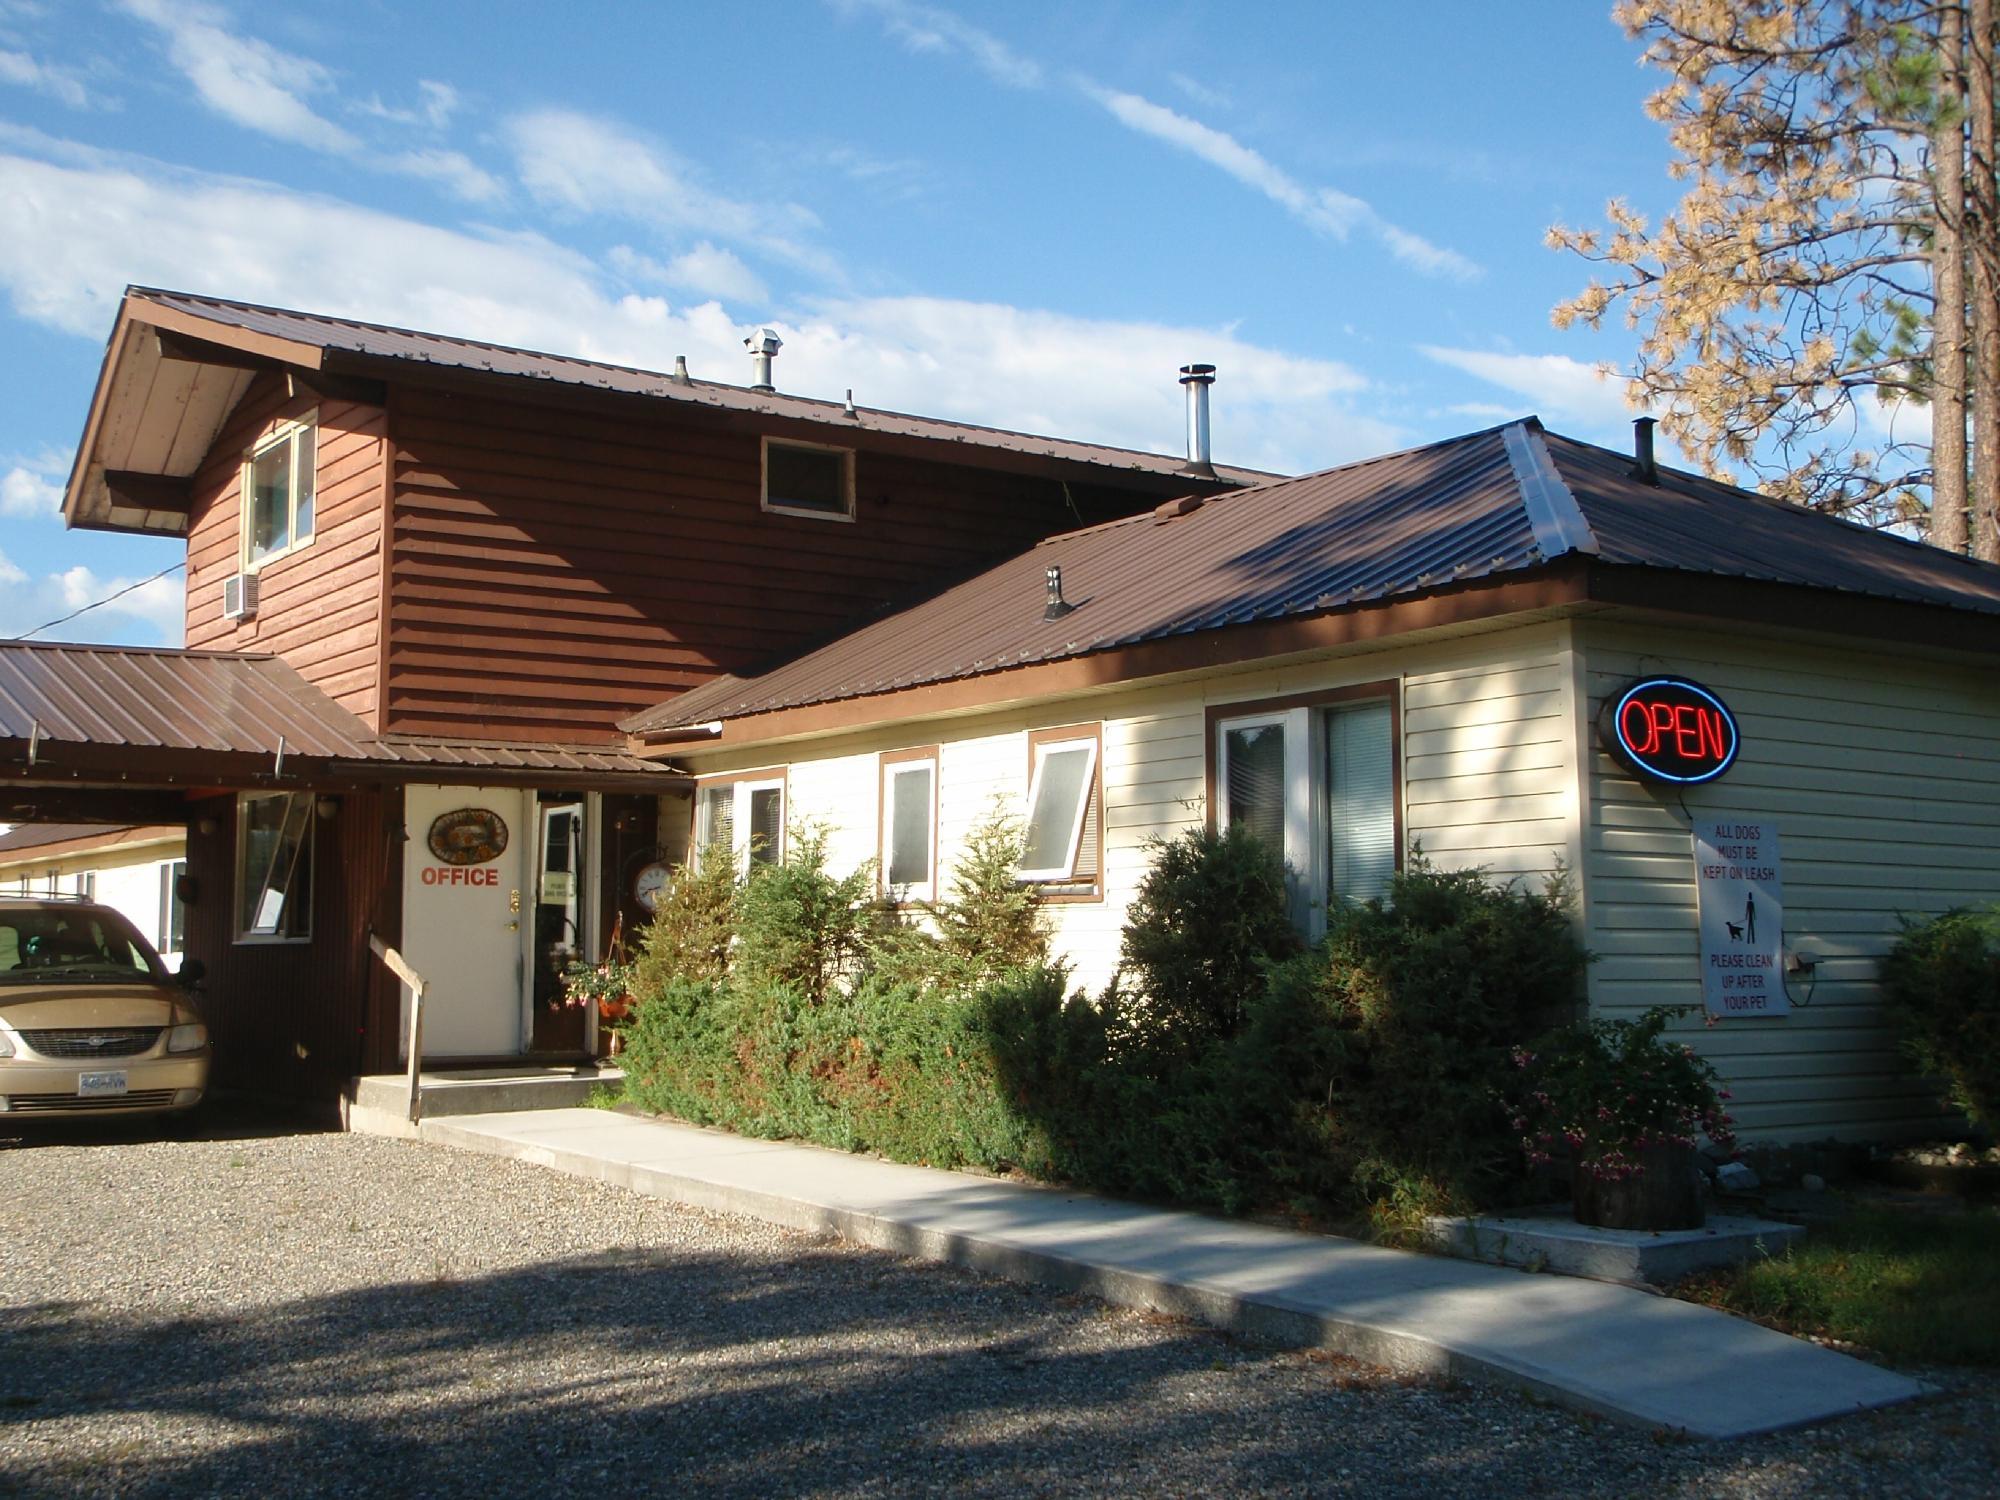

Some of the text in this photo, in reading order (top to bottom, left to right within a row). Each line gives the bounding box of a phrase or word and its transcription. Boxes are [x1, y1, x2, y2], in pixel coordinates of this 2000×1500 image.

[1622, 700, 1723, 759] OPEN
[1715, 824, 1760, 840] ALL DOGS
[1717, 845, 1758, 860] MUST BE
[421, 867, 499, 886] OFFICE
[1703, 865, 1775, 881] KEPT ON LEASH
[1711, 953, 1774, 968] PLEASE CLEAN
[1722, 975, 1765, 988] UP AFTER
[1724, 995, 1767, 1010] YOUR PET
